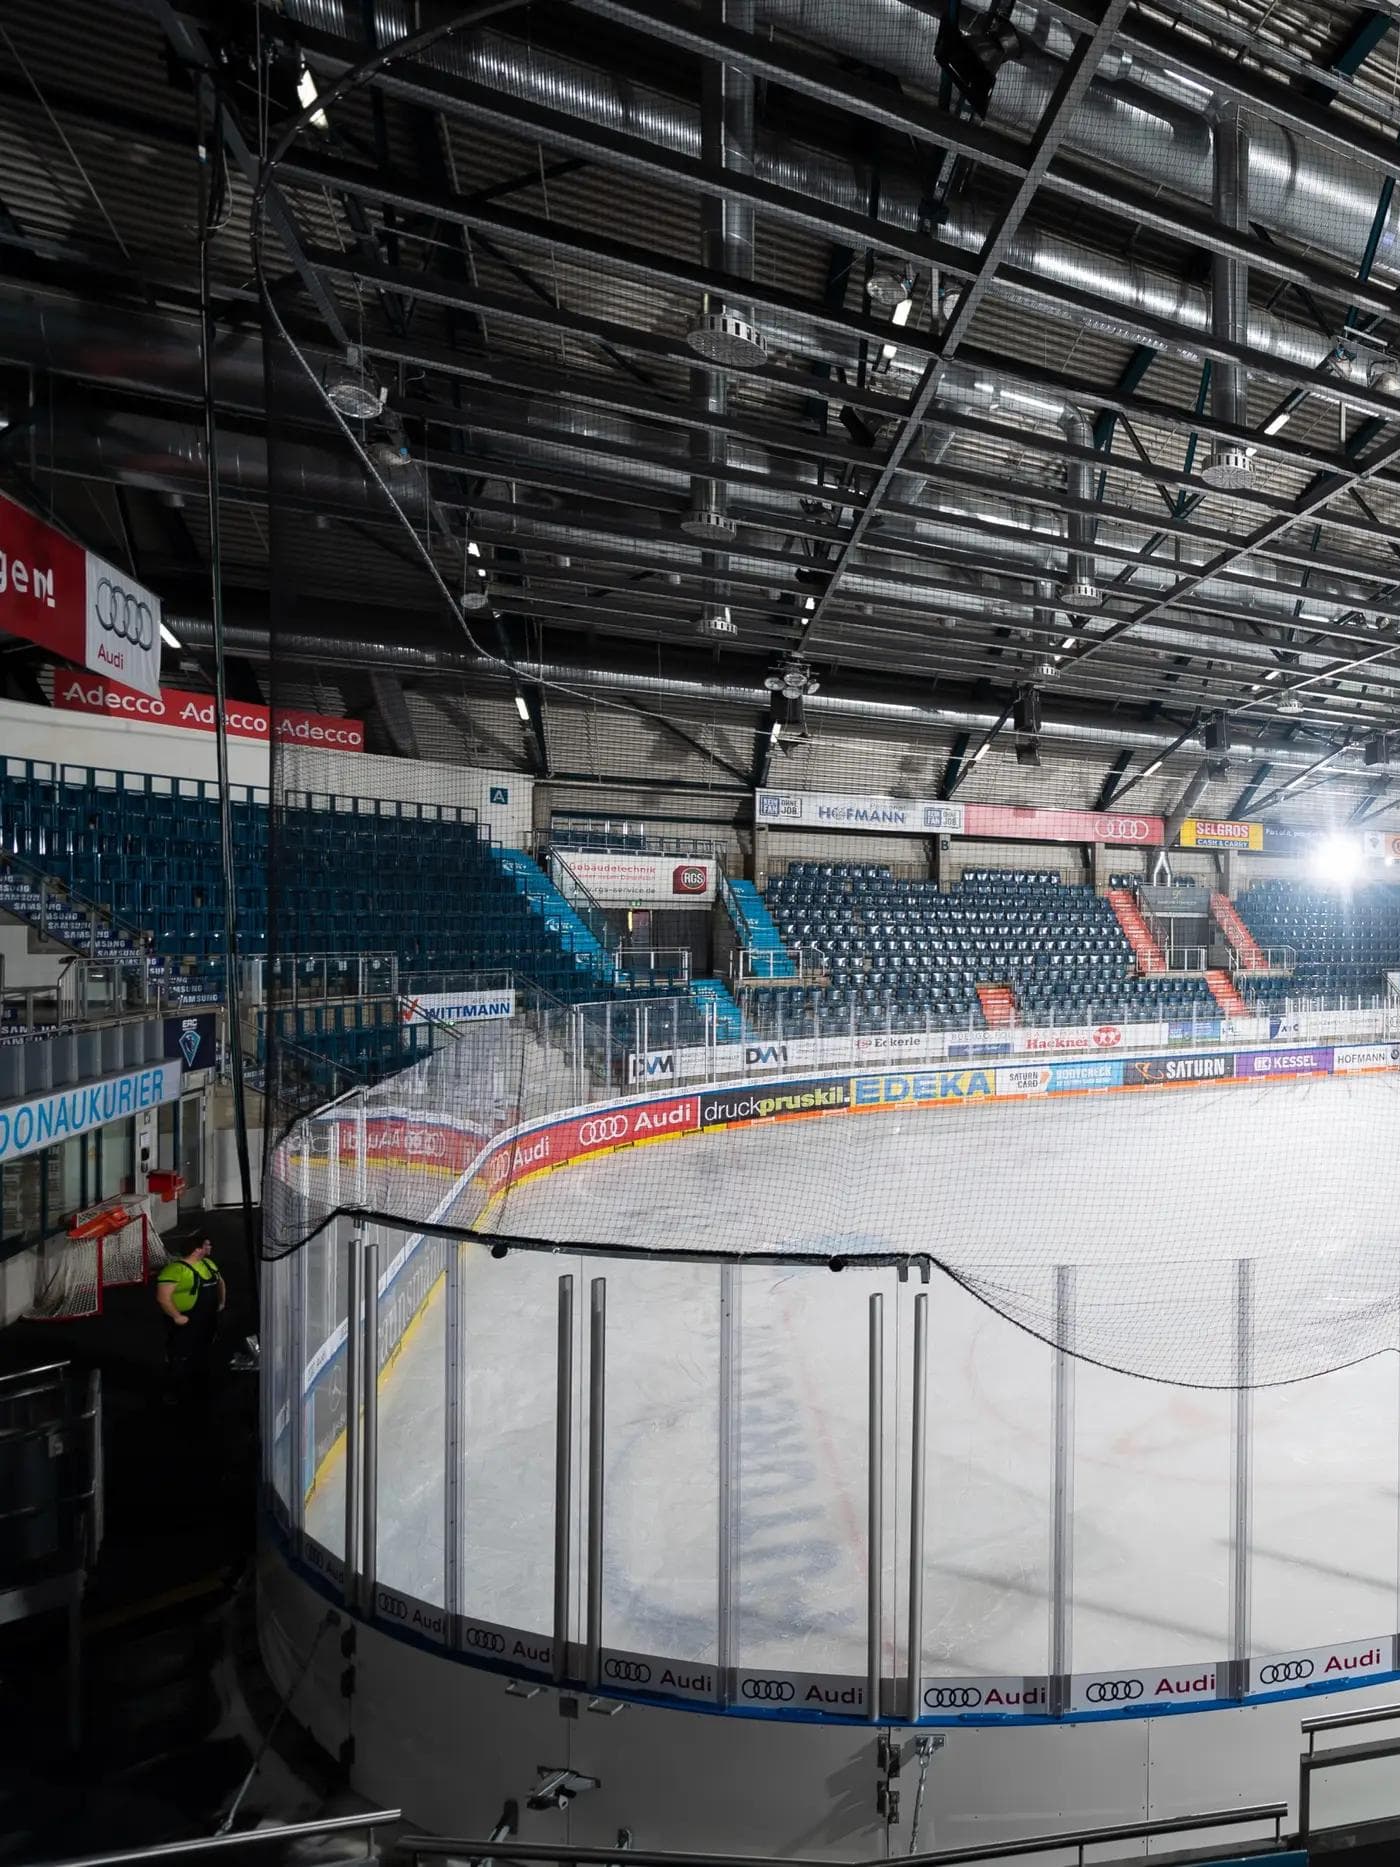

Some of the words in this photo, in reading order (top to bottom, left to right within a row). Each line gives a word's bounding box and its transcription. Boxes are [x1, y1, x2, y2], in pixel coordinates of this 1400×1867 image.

[98, 643, 124, 670] Audi
[63, 683, 165, 716] Adecco
[276, 718, 361, 746] Adecco
[493, 790, 506, 802] A
[1196, 822, 1249, 838] SELGROS
[941, 840, 949, 850] B
[569, 863, 656, 873] Gebäudetechnik
[684, 873, 704, 883] RGS
[64, 931, 109, 939] SAMSNG
[426, 1002, 511, 1019] WITTMANN
[874, 1037, 921, 1048] Eckerle
[745, 1045, 788, 1065] DVM
[1274, 1054, 1317, 1069] KESSEL
[1338, 1052, 1385, 1064] HOFMANN
[1010, 1072, 1038, 1081] SATURN
[1166, 1058, 1225, 1079] SATURN
[856, 1071, 991, 1104] EDEKA
[1018, 1079, 1038, 1088] CARD
[634, 1104, 691, 1132] Audi
[513, 1136, 550, 1170] Audi
[1324, 1649, 1381, 1673] Audi
[660, 1670, 711, 1692] Audi
[1154, 1674, 1216, 1696] Audi
[805, 1685, 863, 1705] Audi
[984, 1688, 1046, 1705] Audi
